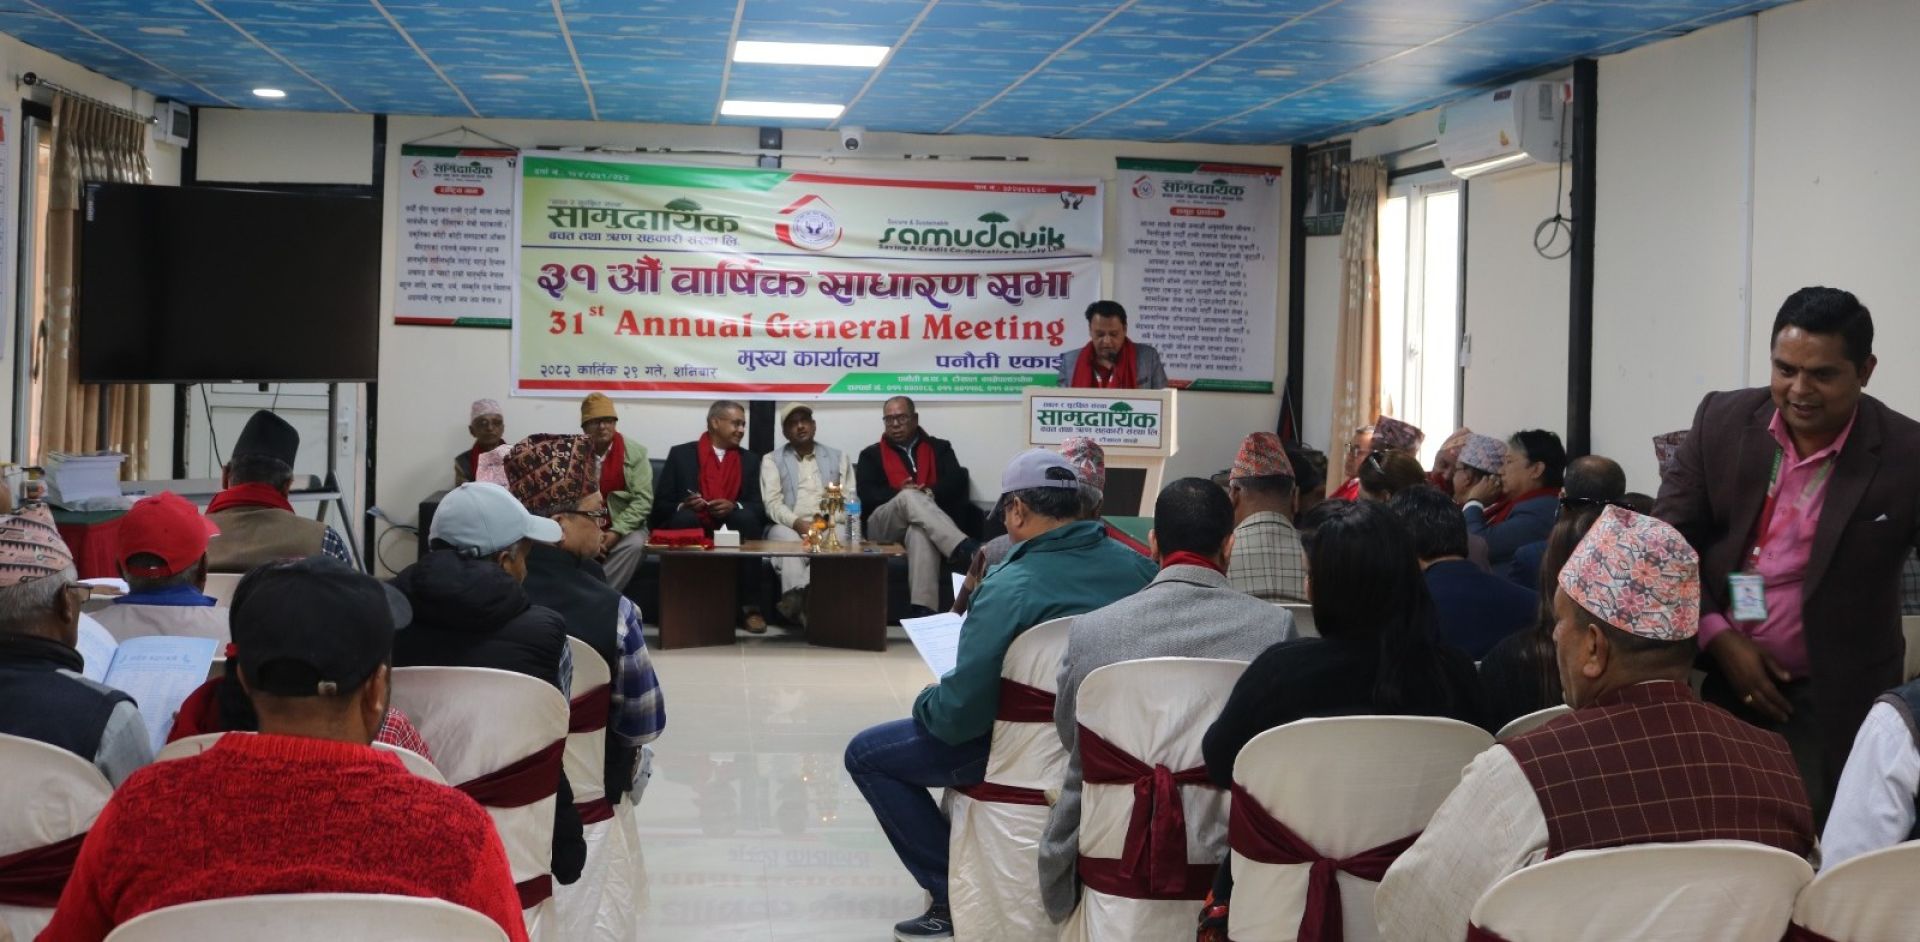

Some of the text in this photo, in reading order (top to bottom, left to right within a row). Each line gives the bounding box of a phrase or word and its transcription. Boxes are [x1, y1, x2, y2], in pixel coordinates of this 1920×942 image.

[547, 203, 742, 233] सामुदायिक
[549, 231, 575, 240] बचत
[578, 232, 601, 241] तथा
[879, 222, 1065, 249] samudayik
[537, 262, 597, 299] ३१
[671, 259, 811, 296] वार्षिक
[818, 271, 980, 308] साधारण
[987, 271, 1073, 304] सभा
[615, 309, 752, 338] Annual
[765, 312, 910, 340] General
[922, 314, 1065, 347] Meeting
[540, 364, 571, 378] २०८२
[577, 361, 618, 376] कार्तिक
[737, 350, 787, 371] मुख्य
[793, 347, 880, 368] कार्यालय
[936, 351, 1000, 369] पनौती
[1037, 409, 1158, 428] सामुदायिक
